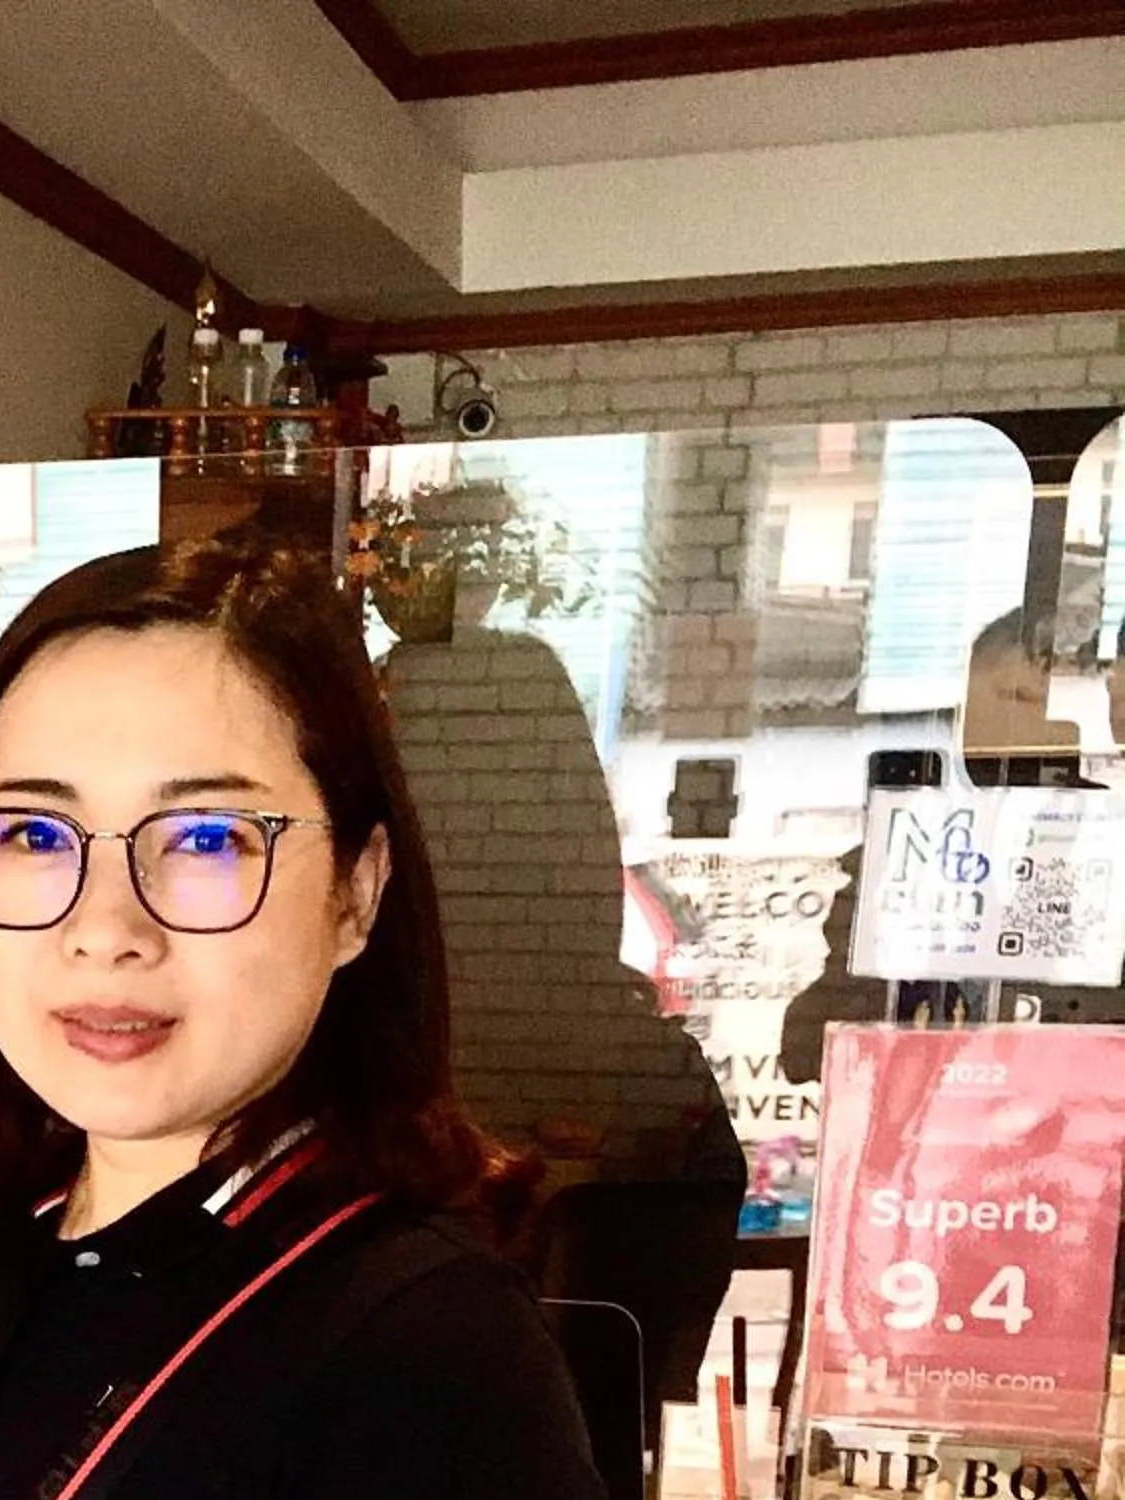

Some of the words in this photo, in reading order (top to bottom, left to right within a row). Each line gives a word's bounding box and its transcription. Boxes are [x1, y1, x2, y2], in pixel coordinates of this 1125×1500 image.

[1036, 902, 1071, 915] LINE
[869, 1189, 1059, 1237] Superb
[879, 1260, 1035, 1335] 9.4
[904, 1362, 1057, 1394] Hotels.com
[833, 1446, 941, 1493] TIP
